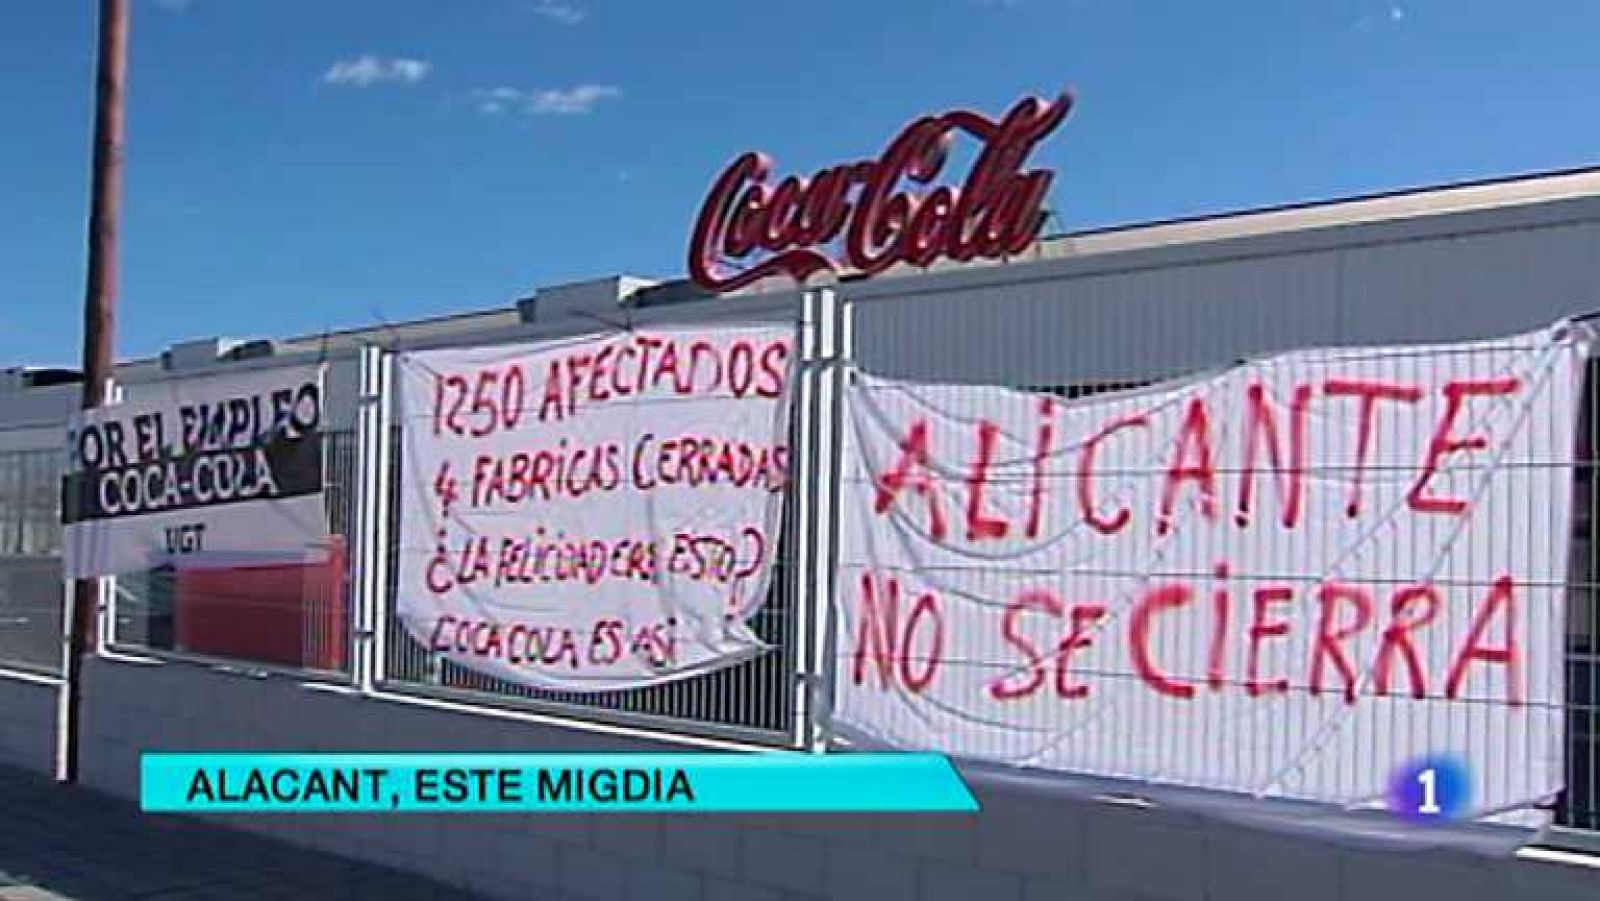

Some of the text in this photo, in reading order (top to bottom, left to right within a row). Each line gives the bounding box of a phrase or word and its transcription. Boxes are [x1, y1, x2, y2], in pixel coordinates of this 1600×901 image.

[66, 382, 320, 468] OR EL EMPLEO
[432, 336, 790, 438] 1250 AFECTADOS
[99, 449, 278, 514] COCA-COLA
[434, 460, 458, 516] 4
[632, 432, 790, 493] CERRADAS
[873, 377, 1521, 541] ALICANTE
[164, 523, 206, 554] UGT
[588, 619, 624, 666] ES
[851, 568, 944, 695] NO
[988, 588, 1108, 702] SE
